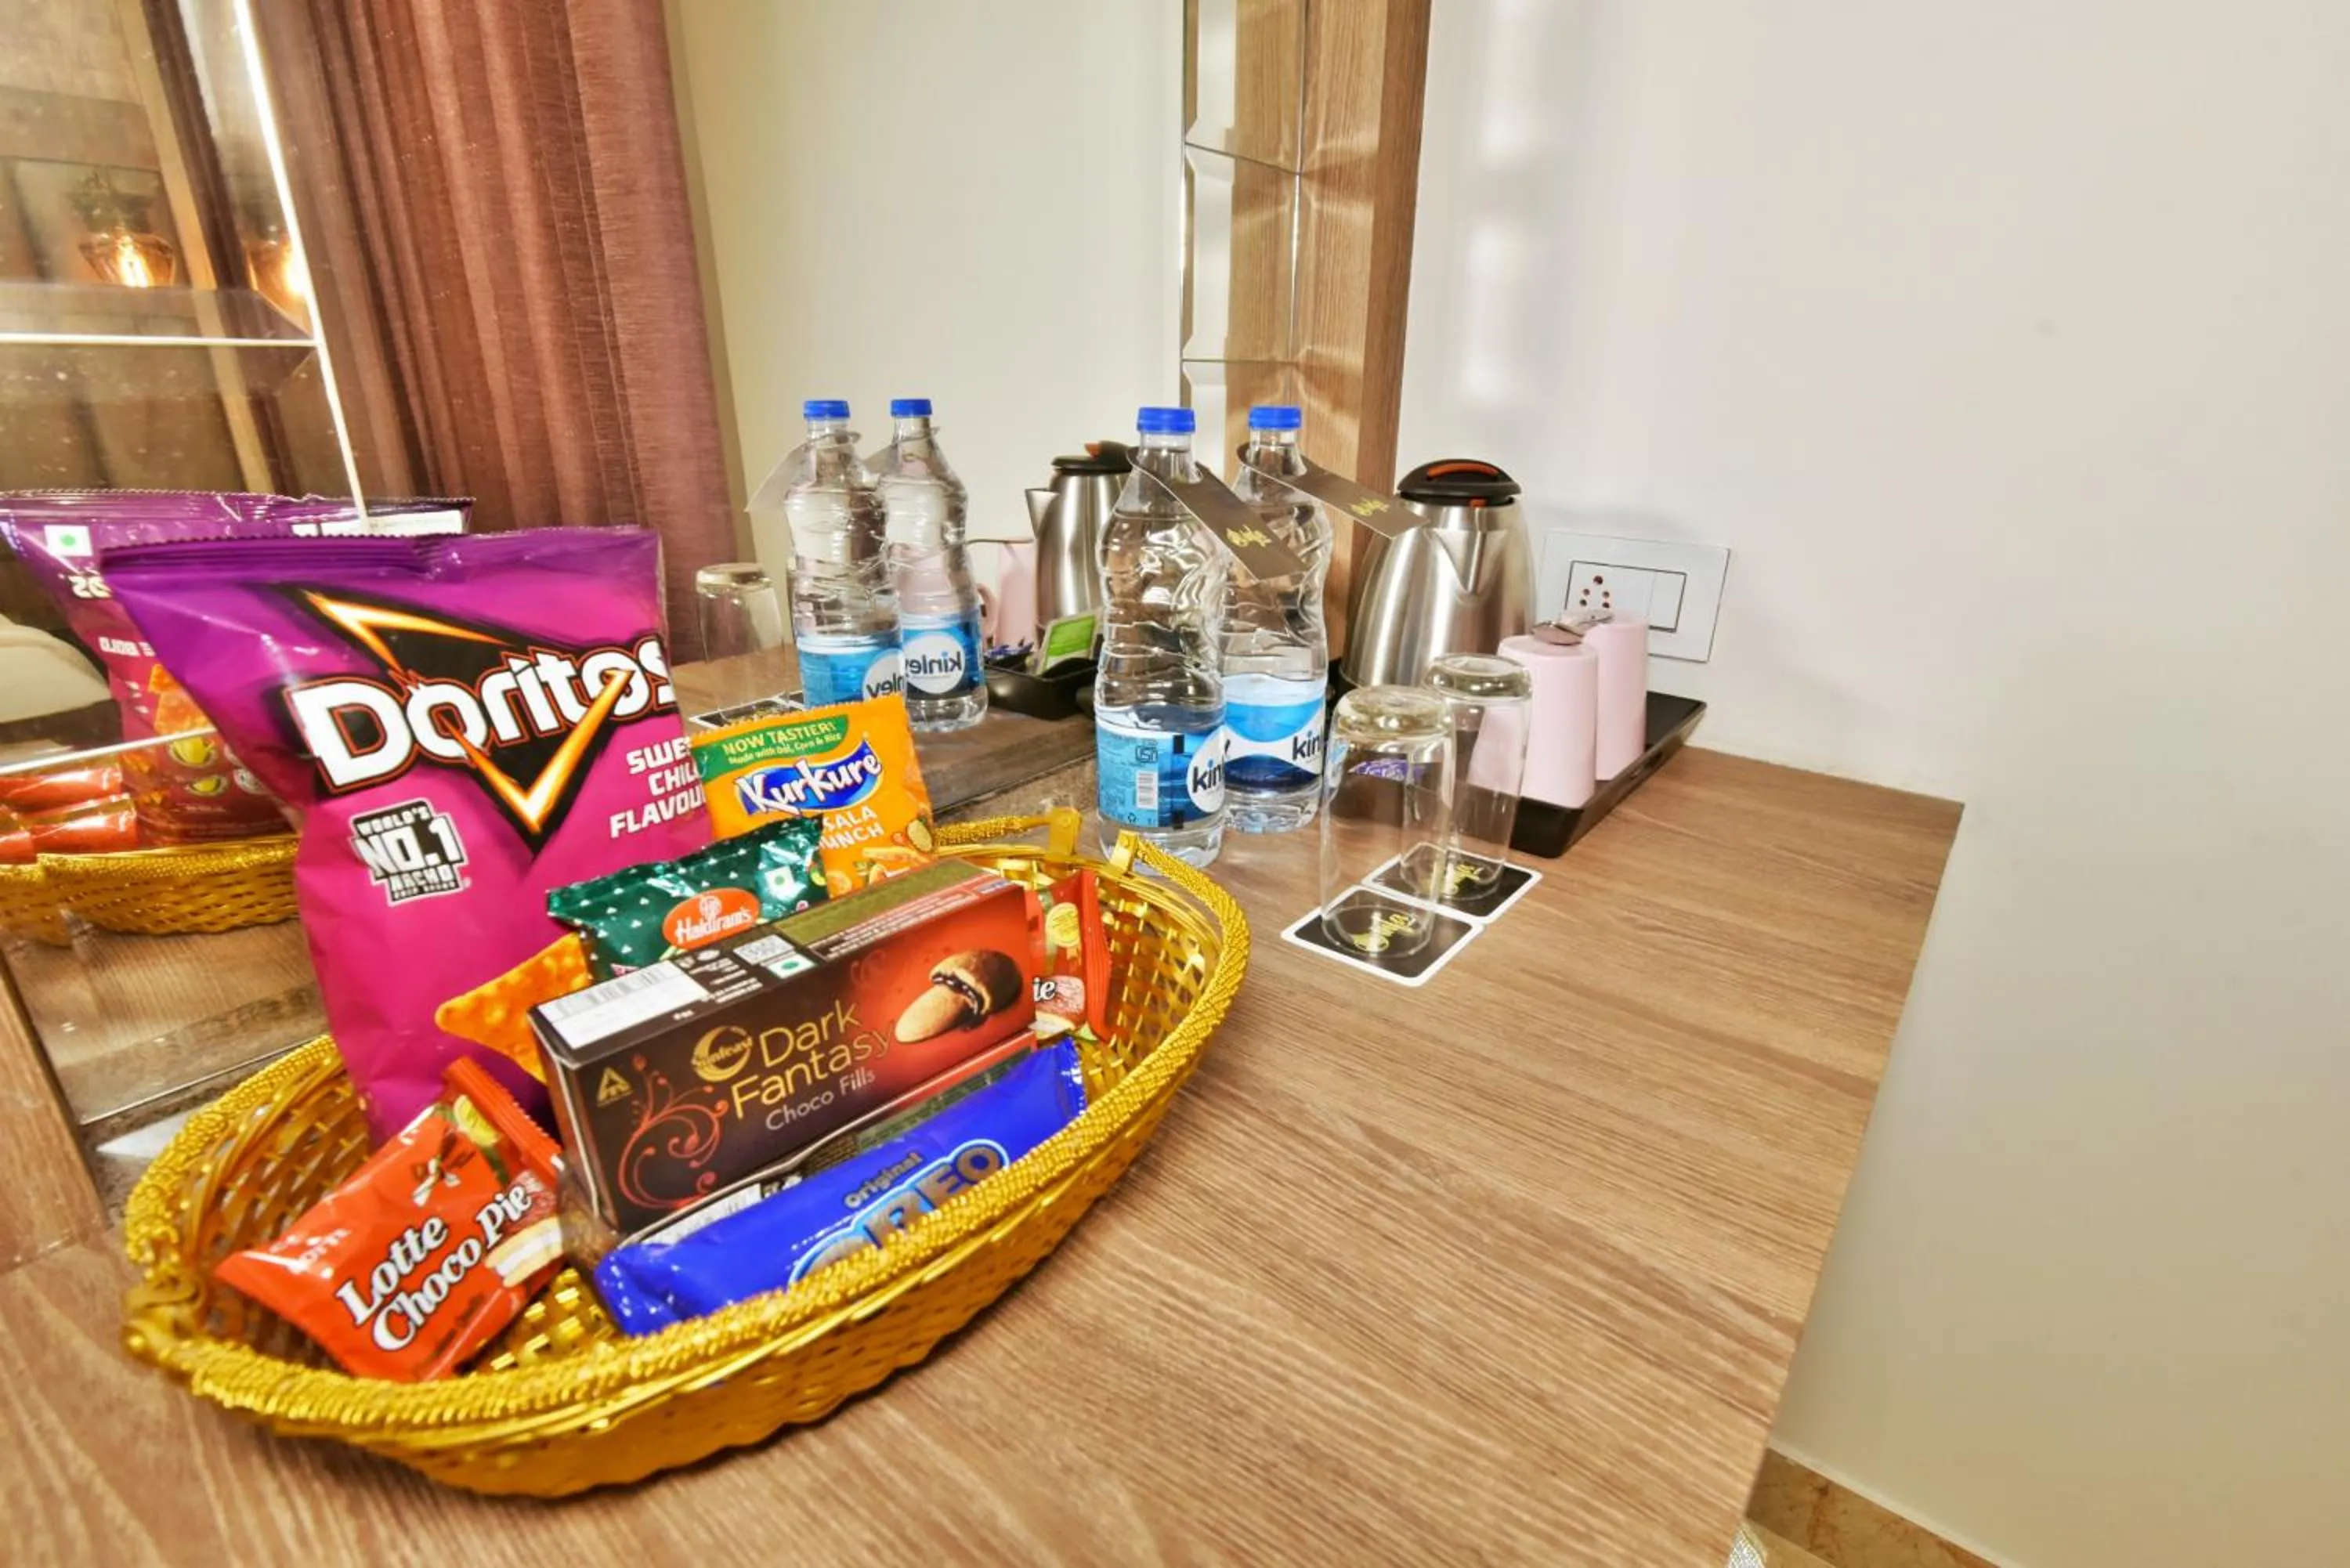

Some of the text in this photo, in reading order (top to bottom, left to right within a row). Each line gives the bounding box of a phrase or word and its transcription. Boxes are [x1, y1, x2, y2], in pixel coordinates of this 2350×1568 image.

[292, 640, 677, 786] Doritos
[721, 721, 837, 755] NOW TASTIER!
[728, 752, 754, 764] Made
[754, 746, 776, 758] with
[735, 753, 883, 815] Kurkure
[357, 806, 431, 836] WORLD'S
[822, 805, 877, 831] SALA
[1032, 976, 1057, 1002] ie
[758, 1000, 862, 1068] Dark
[730, 1022, 895, 1119] Fantasy
[765, 1067, 876, 1130] Choco Fills
[335, 1216, 449, 1326] Lotte
[372, 1183, 533, 1352] Choco Pie
